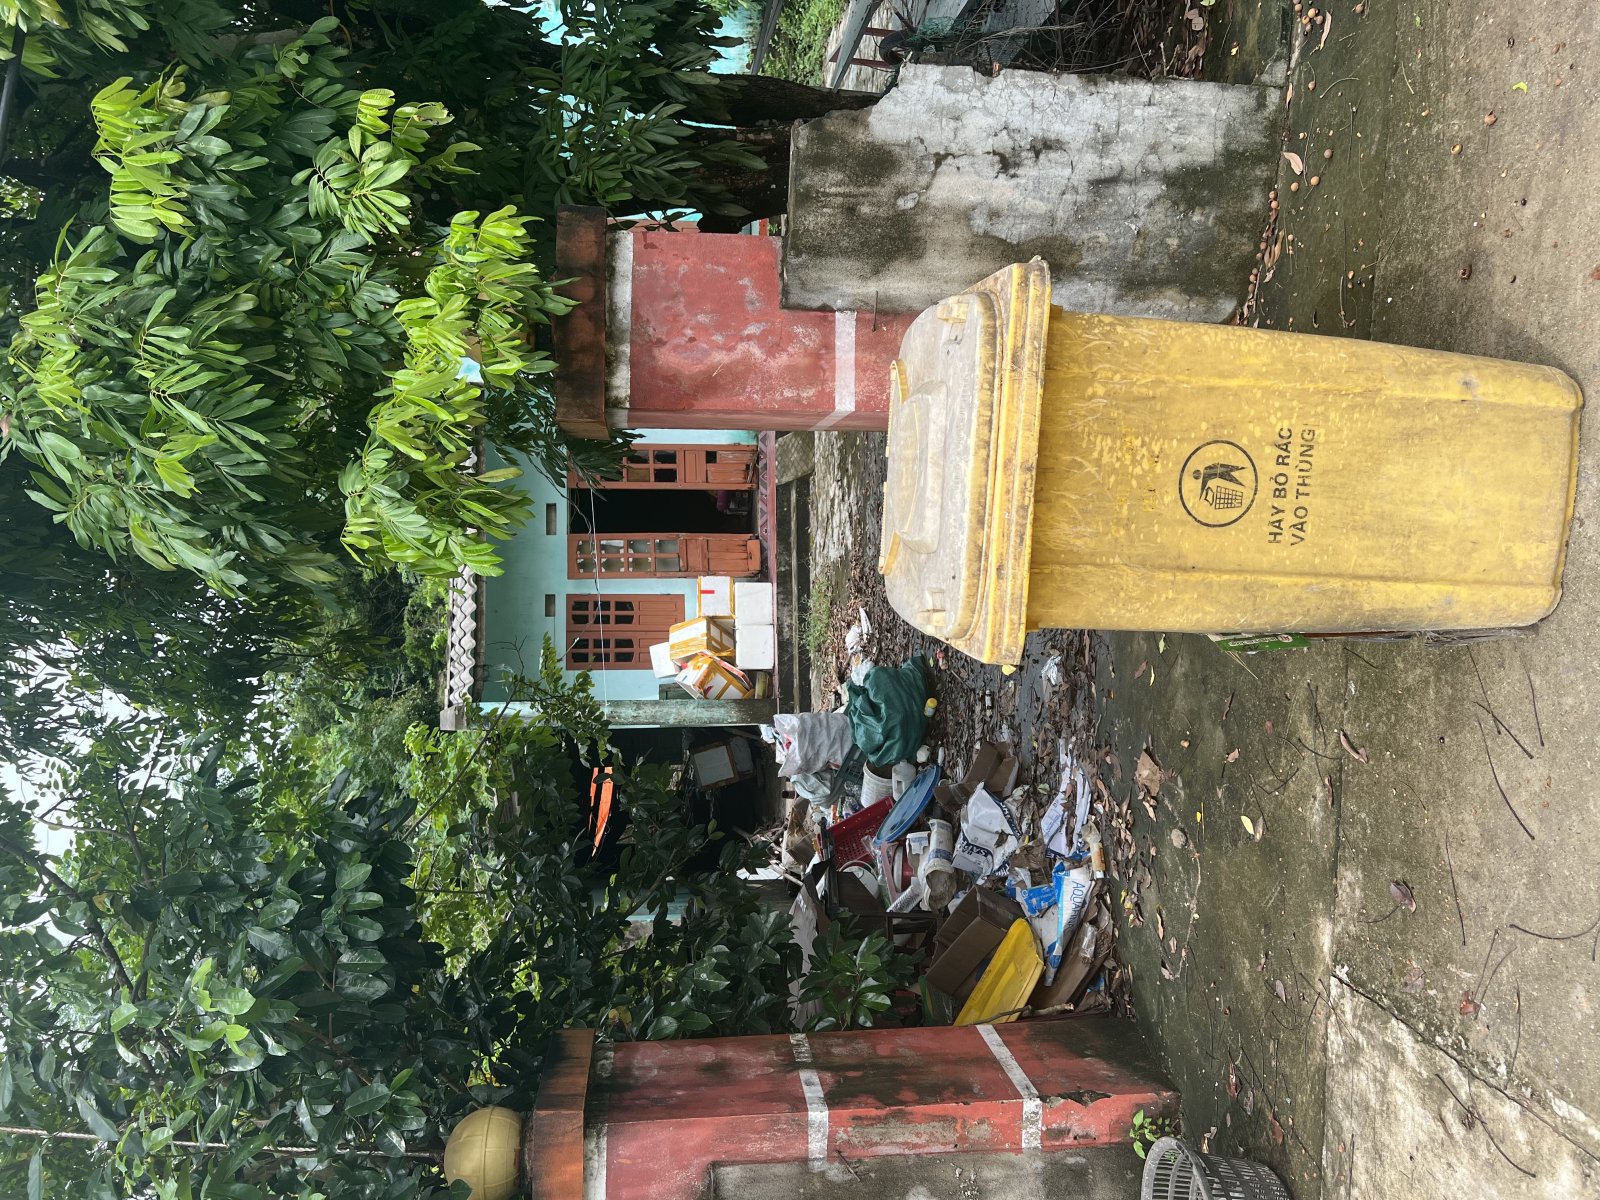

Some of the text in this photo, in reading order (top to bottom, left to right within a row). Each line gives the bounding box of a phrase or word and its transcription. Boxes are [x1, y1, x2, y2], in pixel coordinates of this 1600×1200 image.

[1268, 428, 1292, 543] HÃY BỎ RÁC
[1289, 429, 1315, 546] VÀO THÙNG
